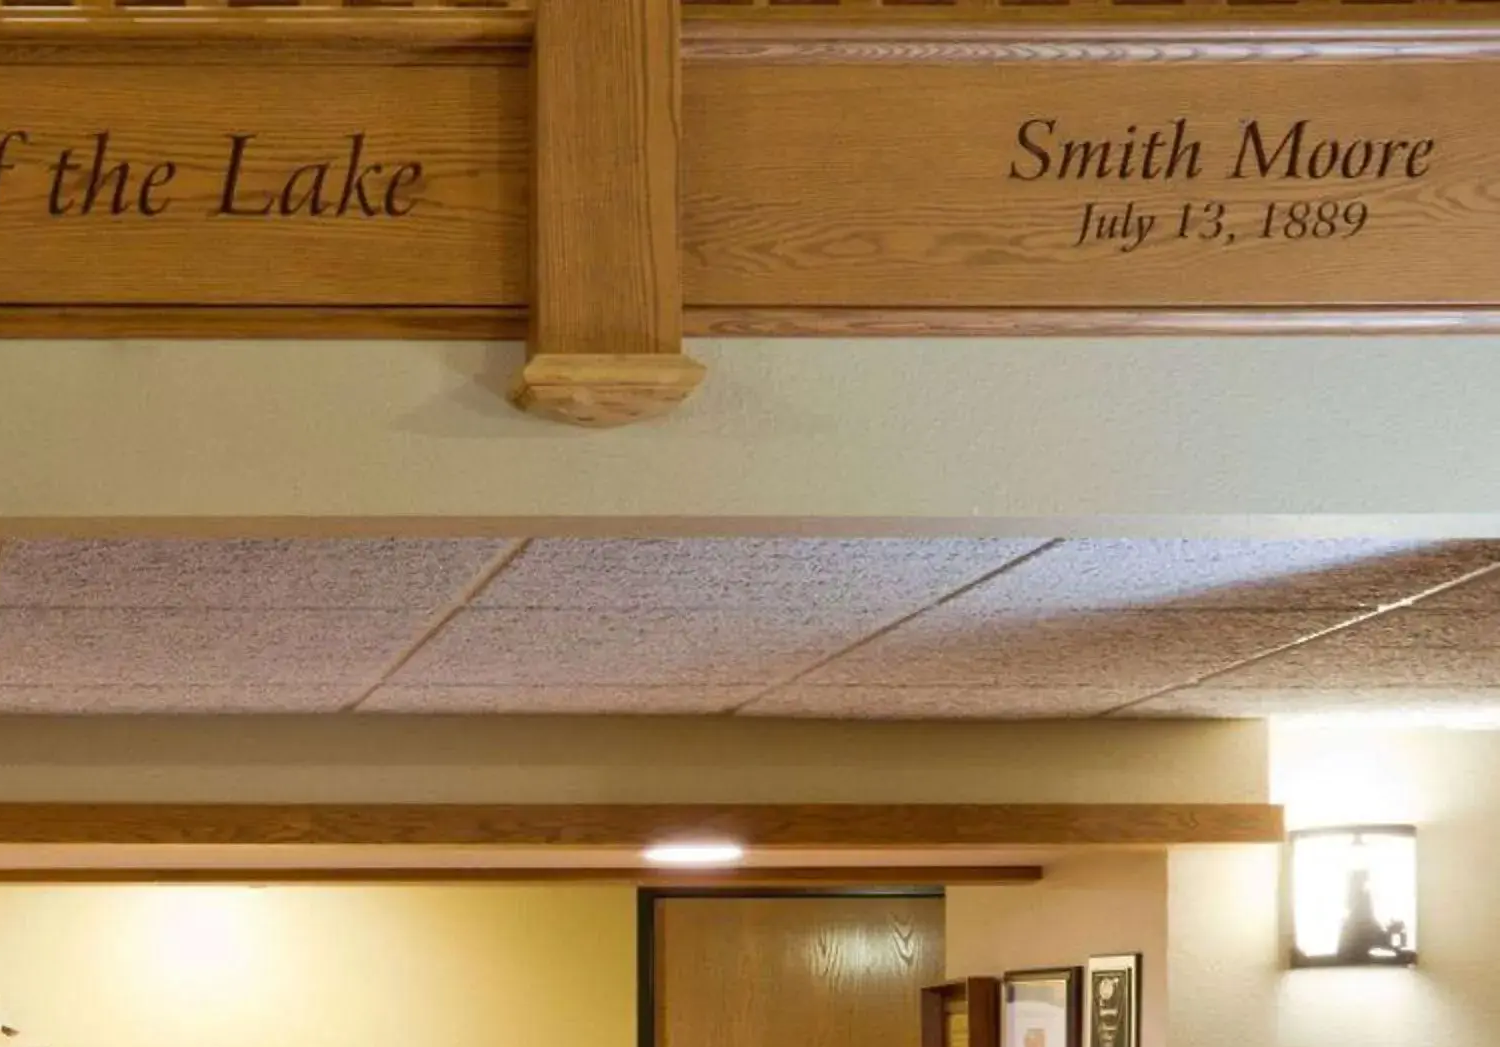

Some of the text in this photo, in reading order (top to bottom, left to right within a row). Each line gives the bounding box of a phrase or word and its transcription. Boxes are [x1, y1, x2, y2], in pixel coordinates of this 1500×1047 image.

[47, 133, 176, 217] the
[214, 133, 424, 218] Lake
[1009, 117, 1435, 181] Smith Moore
[1072, 201, 1369, 253] July 13, 1889
